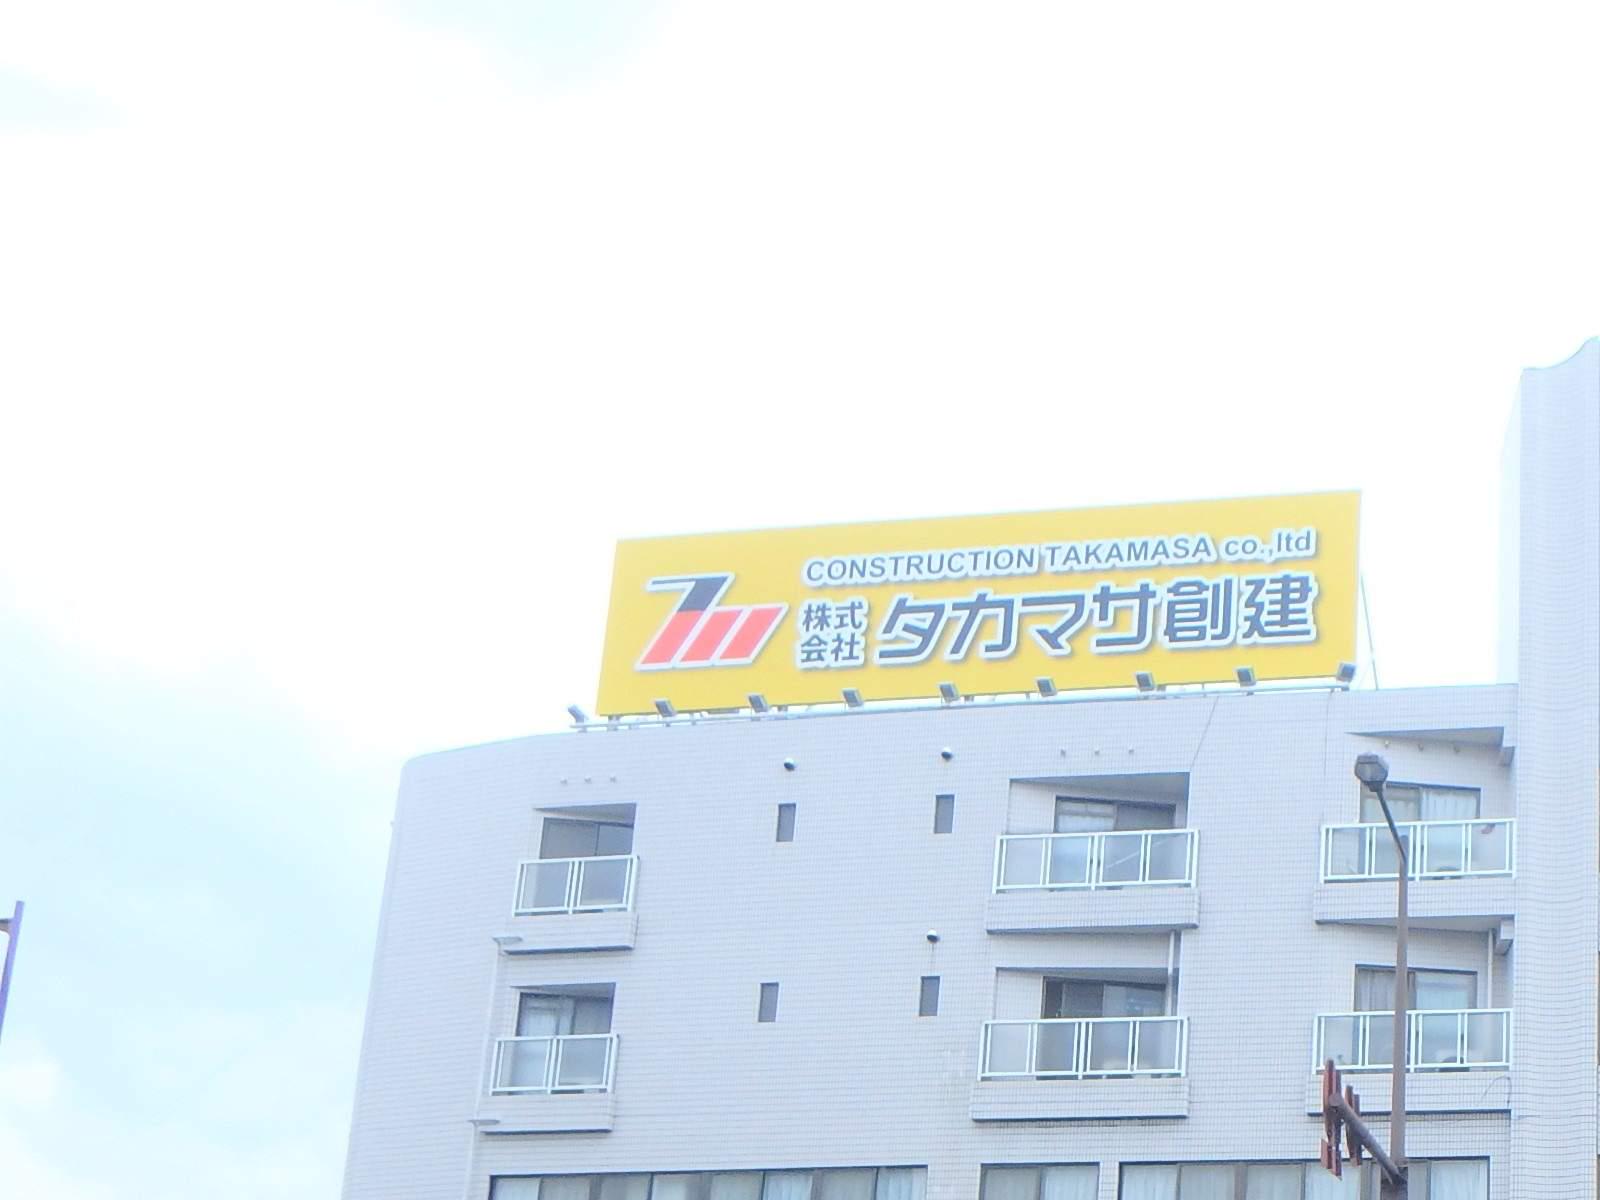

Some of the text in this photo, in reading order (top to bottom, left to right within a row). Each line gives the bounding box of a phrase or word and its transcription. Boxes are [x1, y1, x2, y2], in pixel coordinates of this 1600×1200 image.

[806, 529, 1312, 582] CONSTRUCTION TAKAMASA co.,ltd
[801, 601, 864, 632] 株式
[878, 573, 1313, 660] タカマサ創建
[800, 632, 861, 664] 会社
